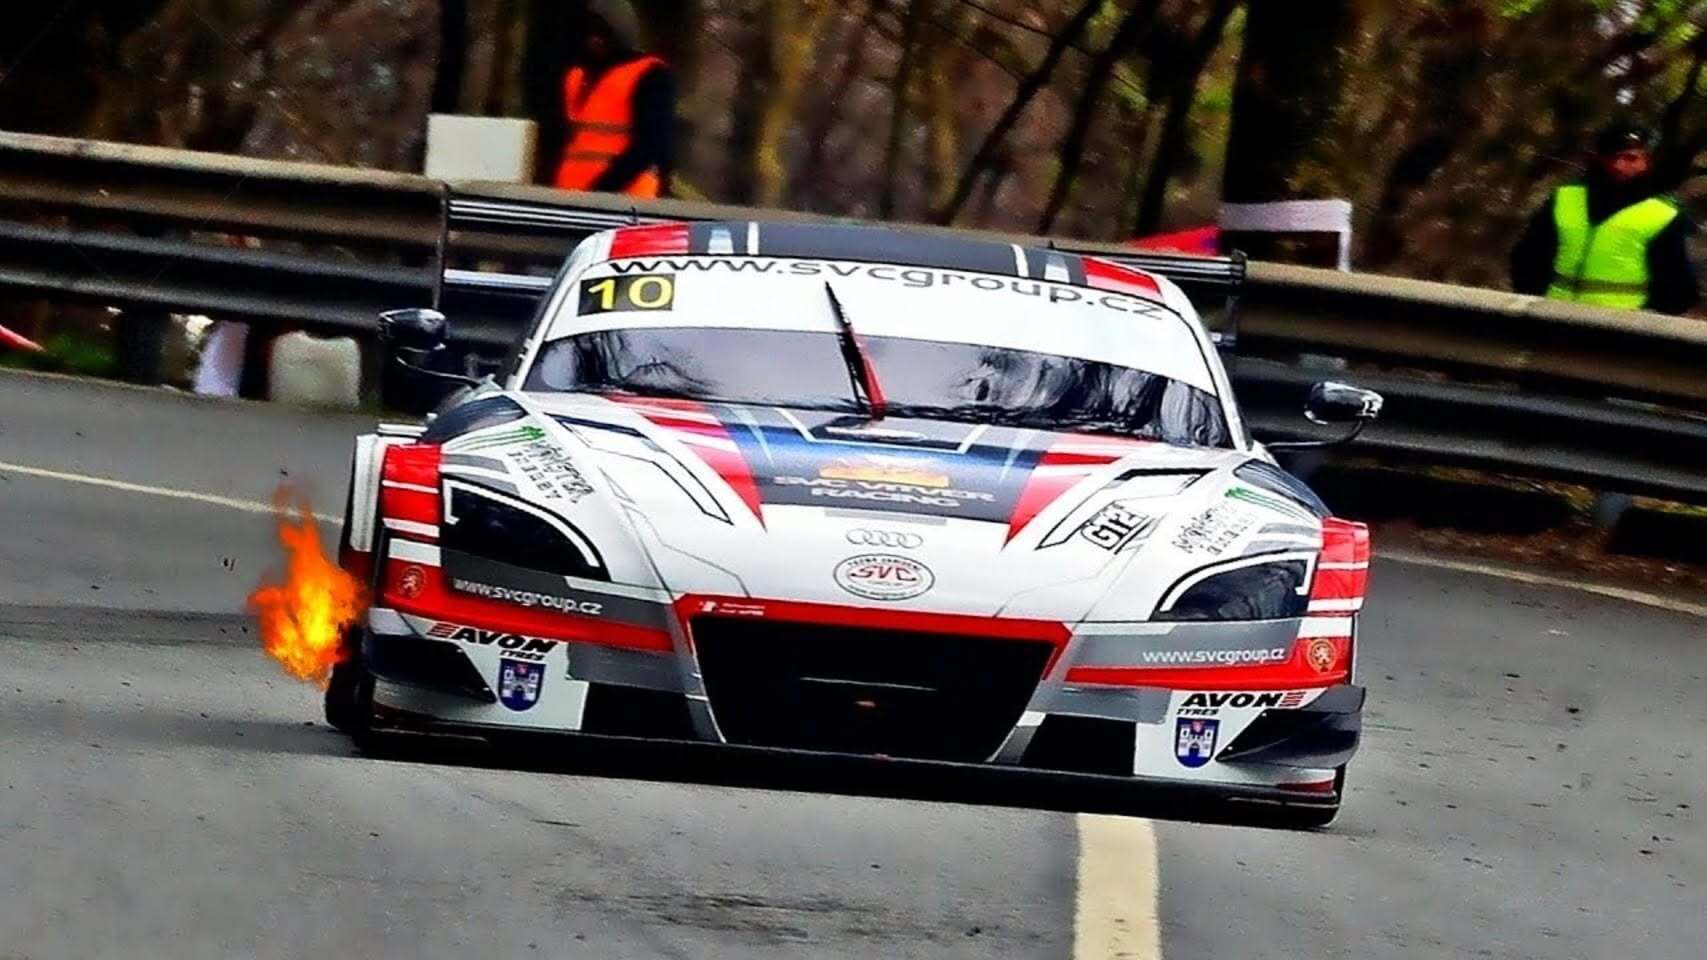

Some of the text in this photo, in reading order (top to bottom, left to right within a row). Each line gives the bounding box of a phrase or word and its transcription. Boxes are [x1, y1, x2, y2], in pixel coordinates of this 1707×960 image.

[588, 276, 673, 311] 10
[610, 259, 1163, 320] www.svcgroup.cz
[774, 475, 849, 488] SVC
[811, 487, 960, 507] RACING
[850, 564, 918, 582] SVC
[453, 578, 604, 615] www.svcgroup.cz
[451, 627, 558, 654] AVON
[1142, 647, 1285, 666] www.svcgroup.cz
[1181, 692, 1284, 708] AVON
